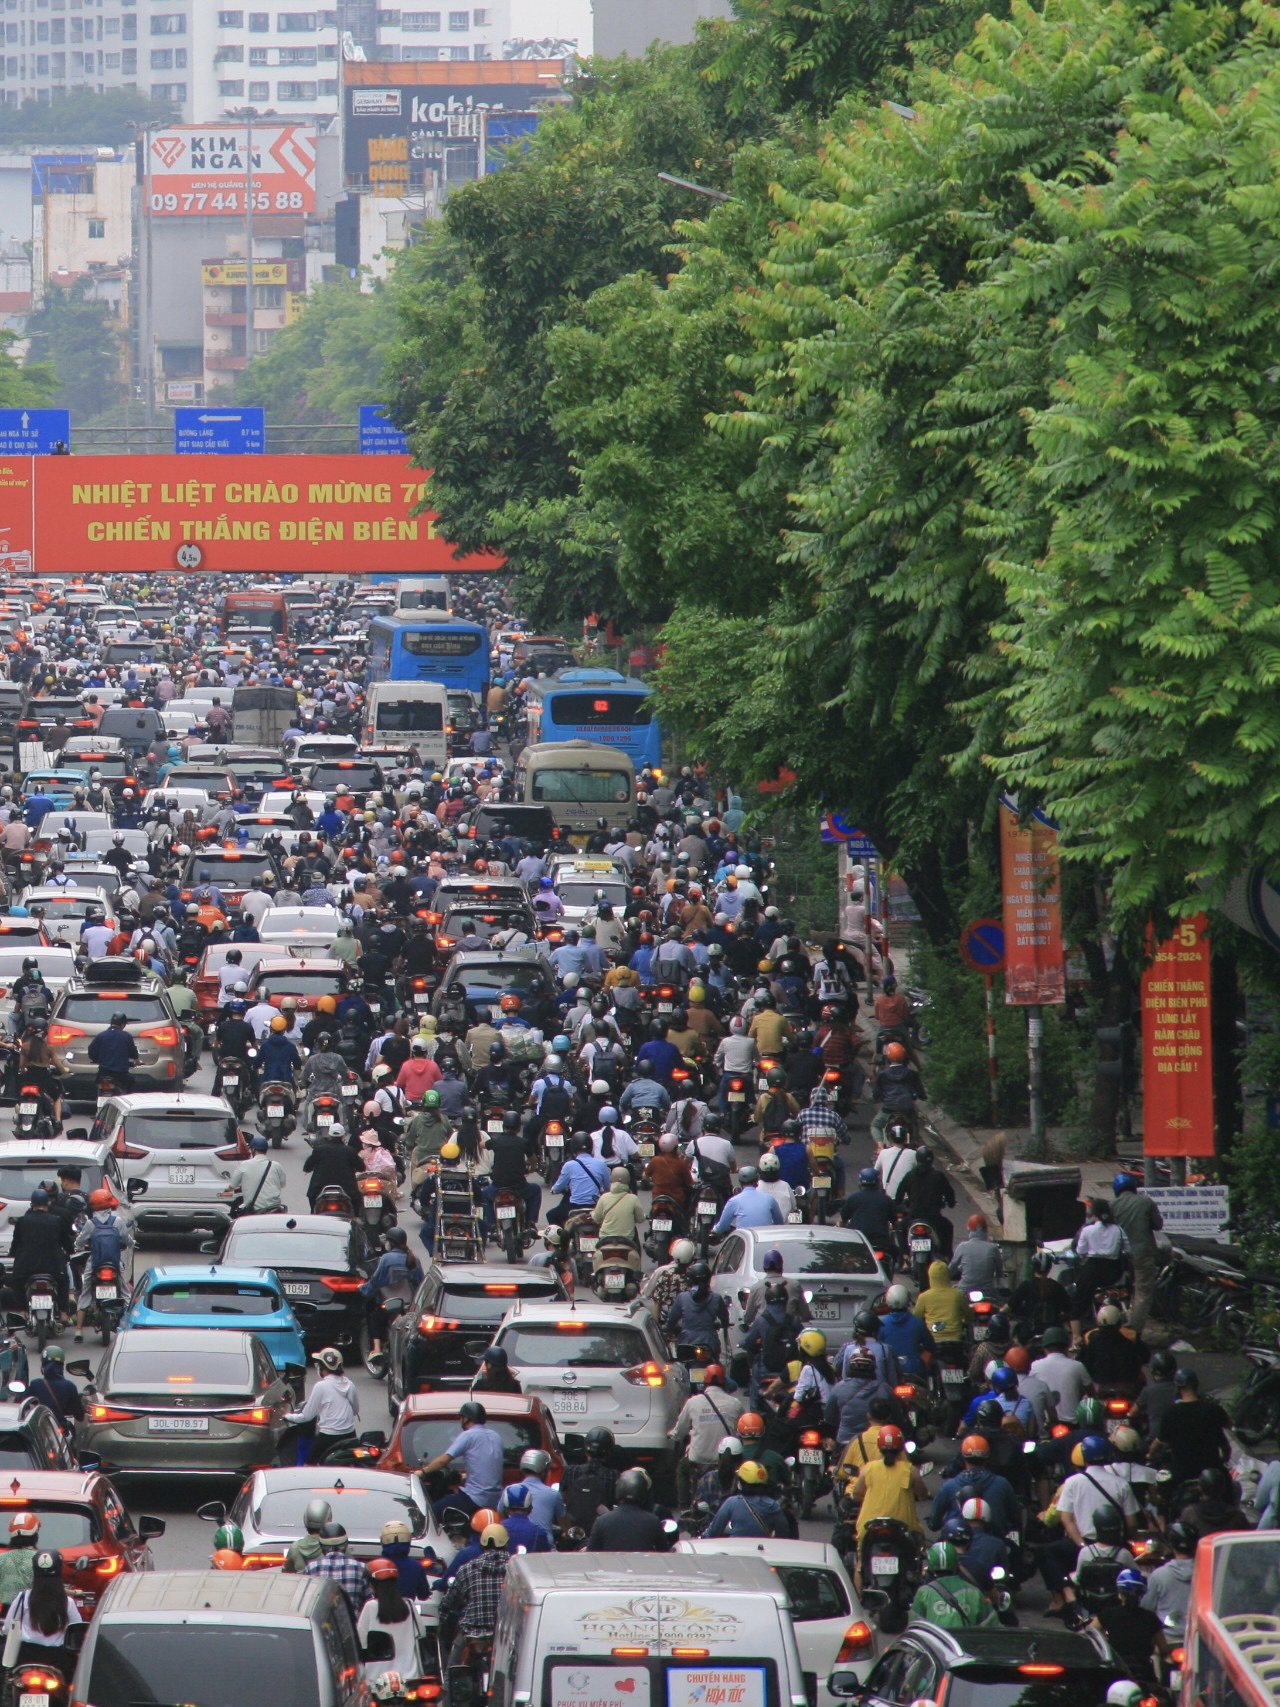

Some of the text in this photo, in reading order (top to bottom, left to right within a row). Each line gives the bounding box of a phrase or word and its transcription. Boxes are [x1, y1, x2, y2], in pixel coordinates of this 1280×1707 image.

[191, 137, 236, 152] KIM
[151, 193, 178, 211] 09
[181, 193, 208, 211] 77
[211, 192, 238, 210] 44
[275, 191, 303, 209] 88
[72, 480, 152, 508] NHIỆT
[161, 480, 216, 508] LIỆT
[225, 479, 299, 503] CHÀO
[308, 479, 391, 503] MỪNG
[88, 513, 418, 546] CHIẾN THẮNG ĐIỆN BIÊN
[1173, 924, 1197, 946] -5
[1156, 952, 1202, 962] 954-2024
[176, 1166, 187, 1174] 30F
[815, 1311, 836, 1319] 12.15
[561, 1391, 578, 1400] 30E
[554, 1402, 584, 1411] 598.84
[153, 1420, 204, 1429] 30L-078.97
[641, 1604, 677, 1614] VIP
[932, 1599, 971, 1616] Grb
[583, 1621, 736, 1634] HOÀNG CÔNG
[607, 1631, 655, 1640] Hotline:
[658, 1631, 683, 1640] 1900
[723, 1672, 746, 1683] HÀNG
